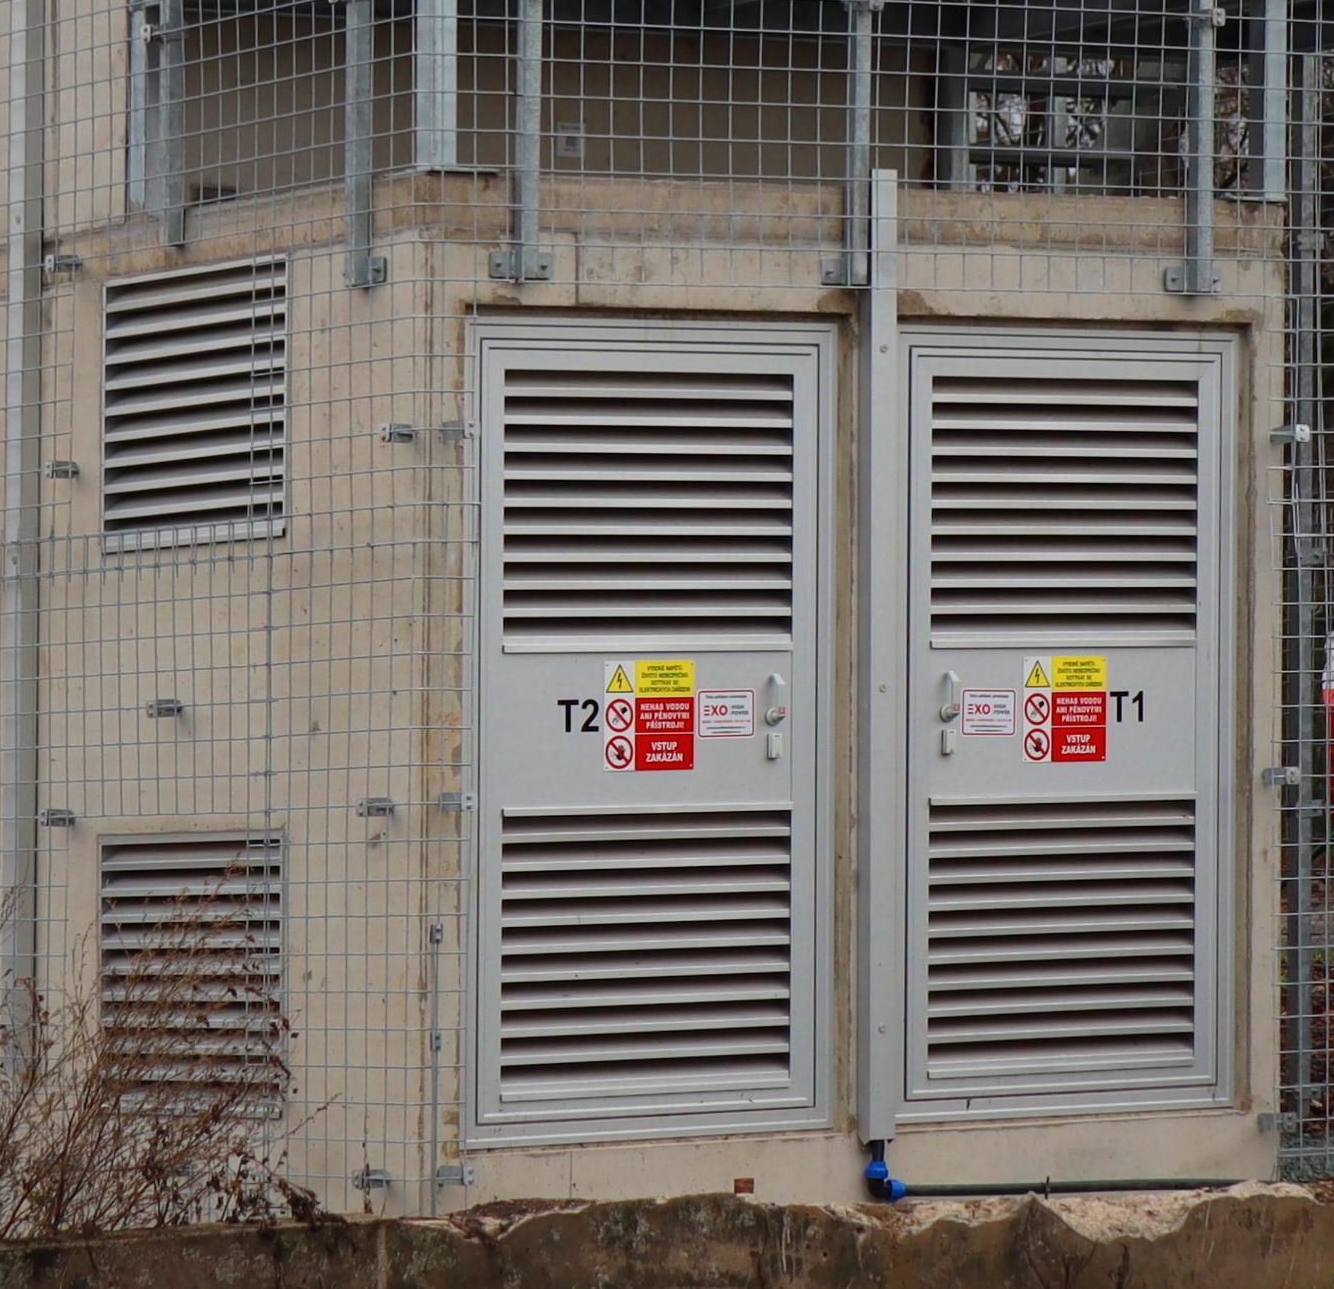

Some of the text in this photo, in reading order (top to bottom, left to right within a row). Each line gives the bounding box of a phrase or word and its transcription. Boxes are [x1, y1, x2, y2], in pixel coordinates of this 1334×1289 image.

[665, 702, 689, 710] VODOU
[1079, 697, 1102, 705] VODOU
[703, 704, 728, 716] EXO
[967, 704, 990, 714] EXO
[1110, 691, 1144, 722] T1
[557, 699, 599, 732] T2
[639, 712, 652, 720] ANI
[1066, 734, 1091, 743] VSTUP
[651, 741, 678, 751] VSTUP
[1061, 743, 1096, 754] ZAKÁZÁN
[646, 751, 683, 763] ZAKÁZÁN
